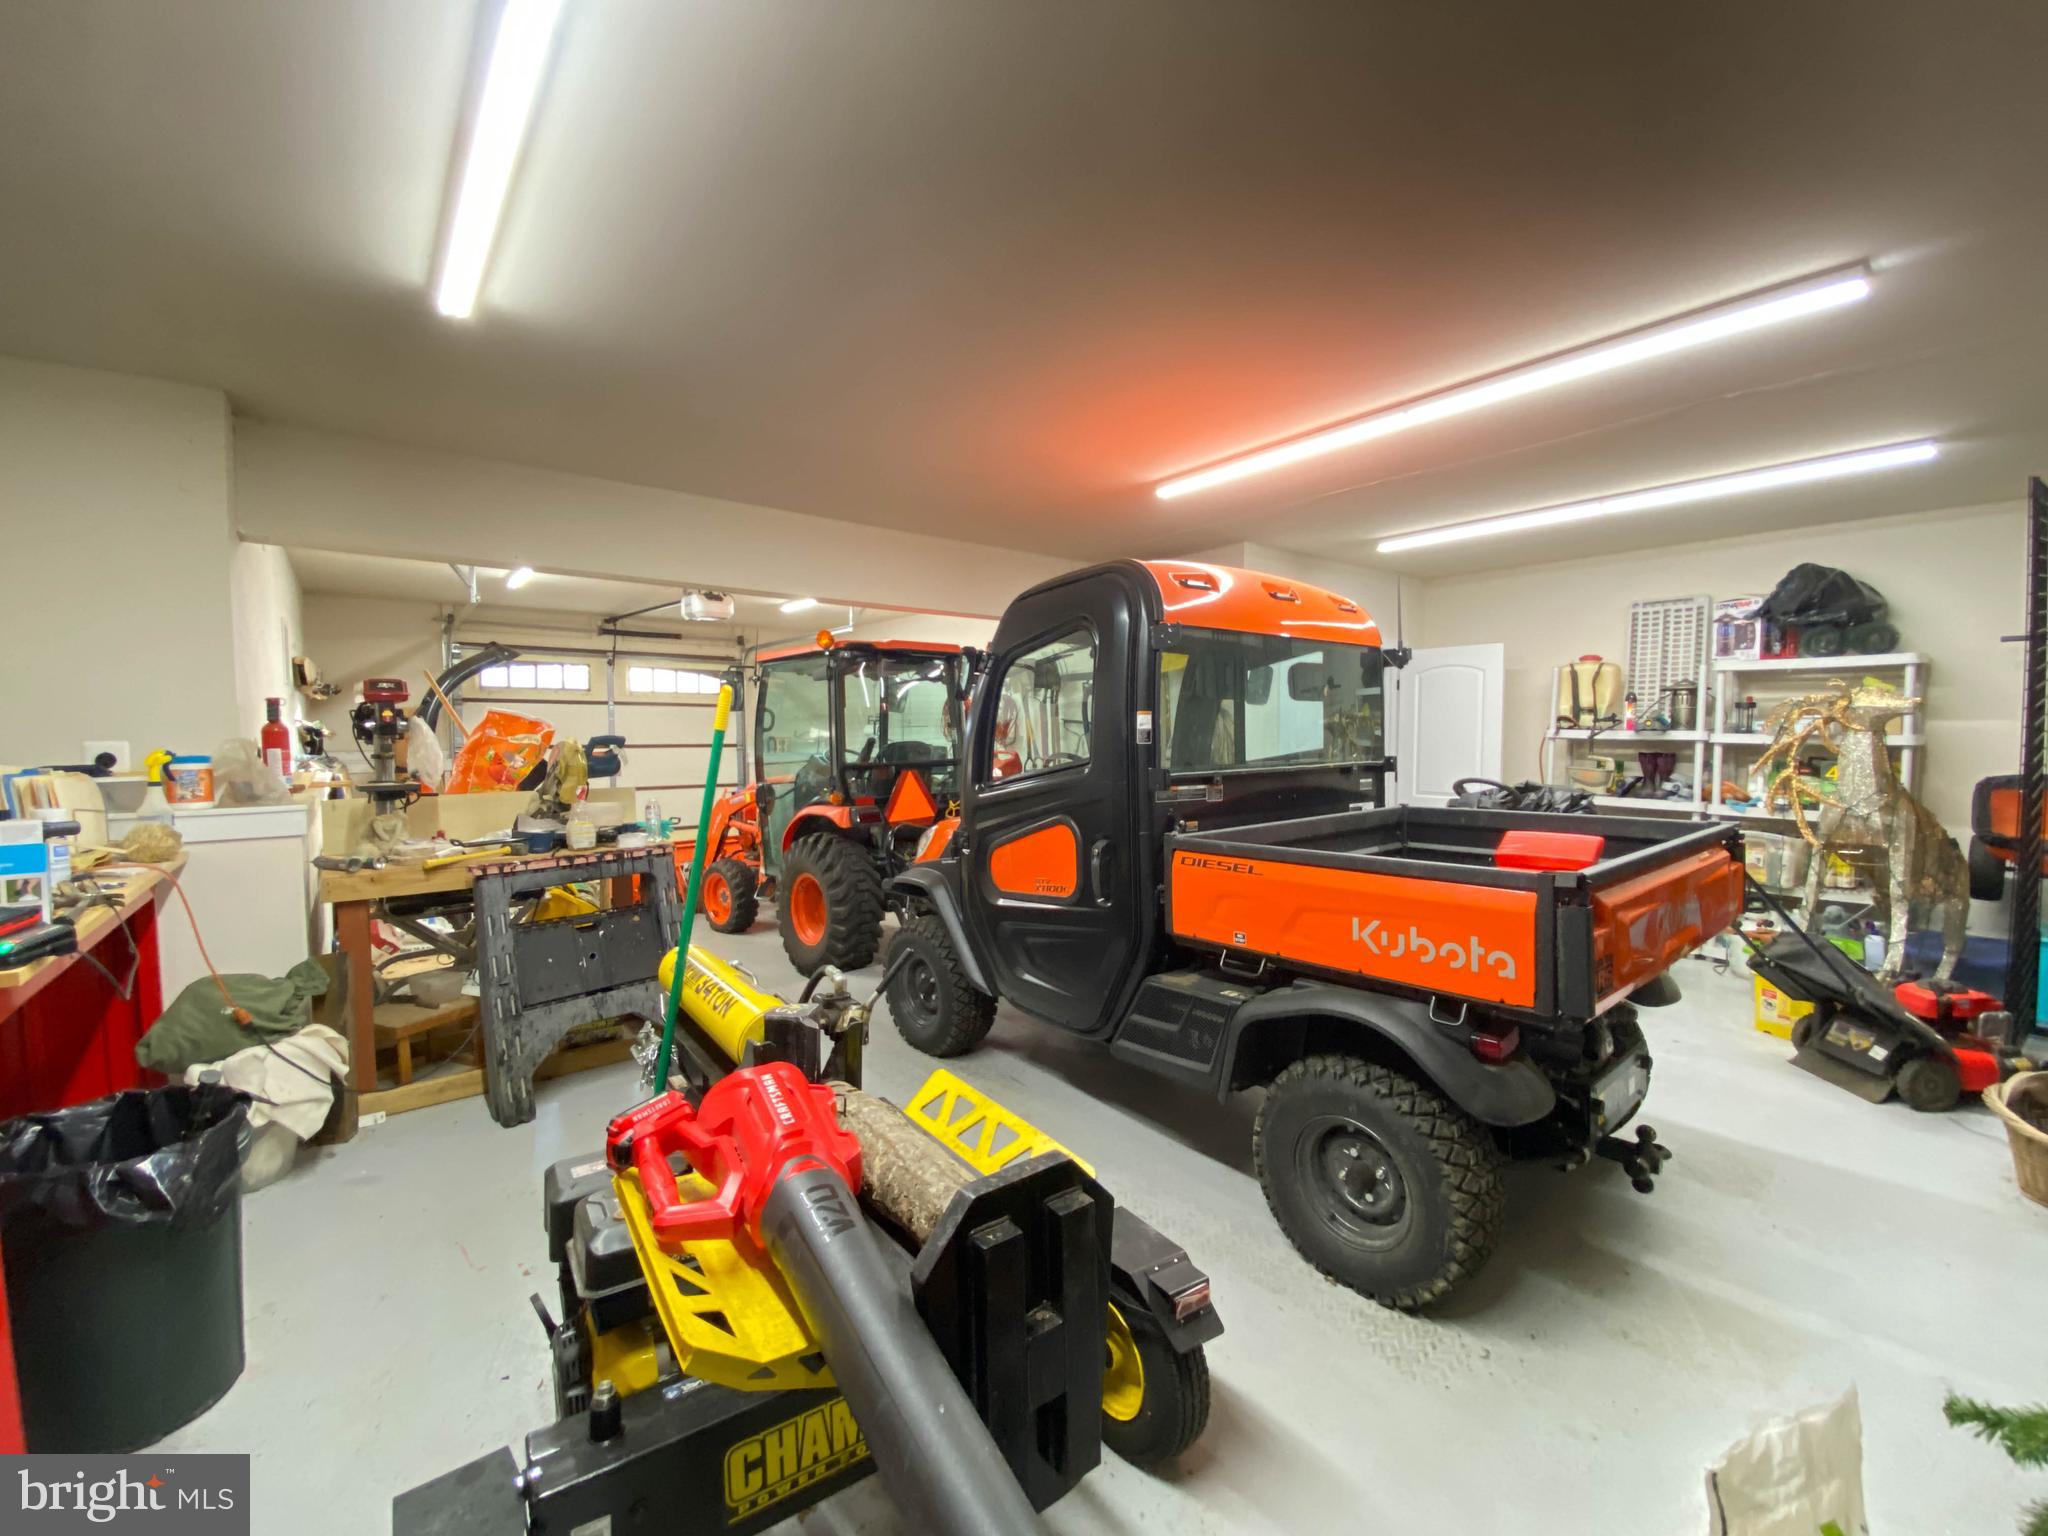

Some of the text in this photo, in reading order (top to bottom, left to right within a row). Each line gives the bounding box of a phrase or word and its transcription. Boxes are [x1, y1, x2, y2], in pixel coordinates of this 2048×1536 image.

[1181, 856, 1264, 876] DIESEL
[1352, 916, 1516, 980] Kubota
[760, 1073, 795, 1126] CRAFTSMAN
